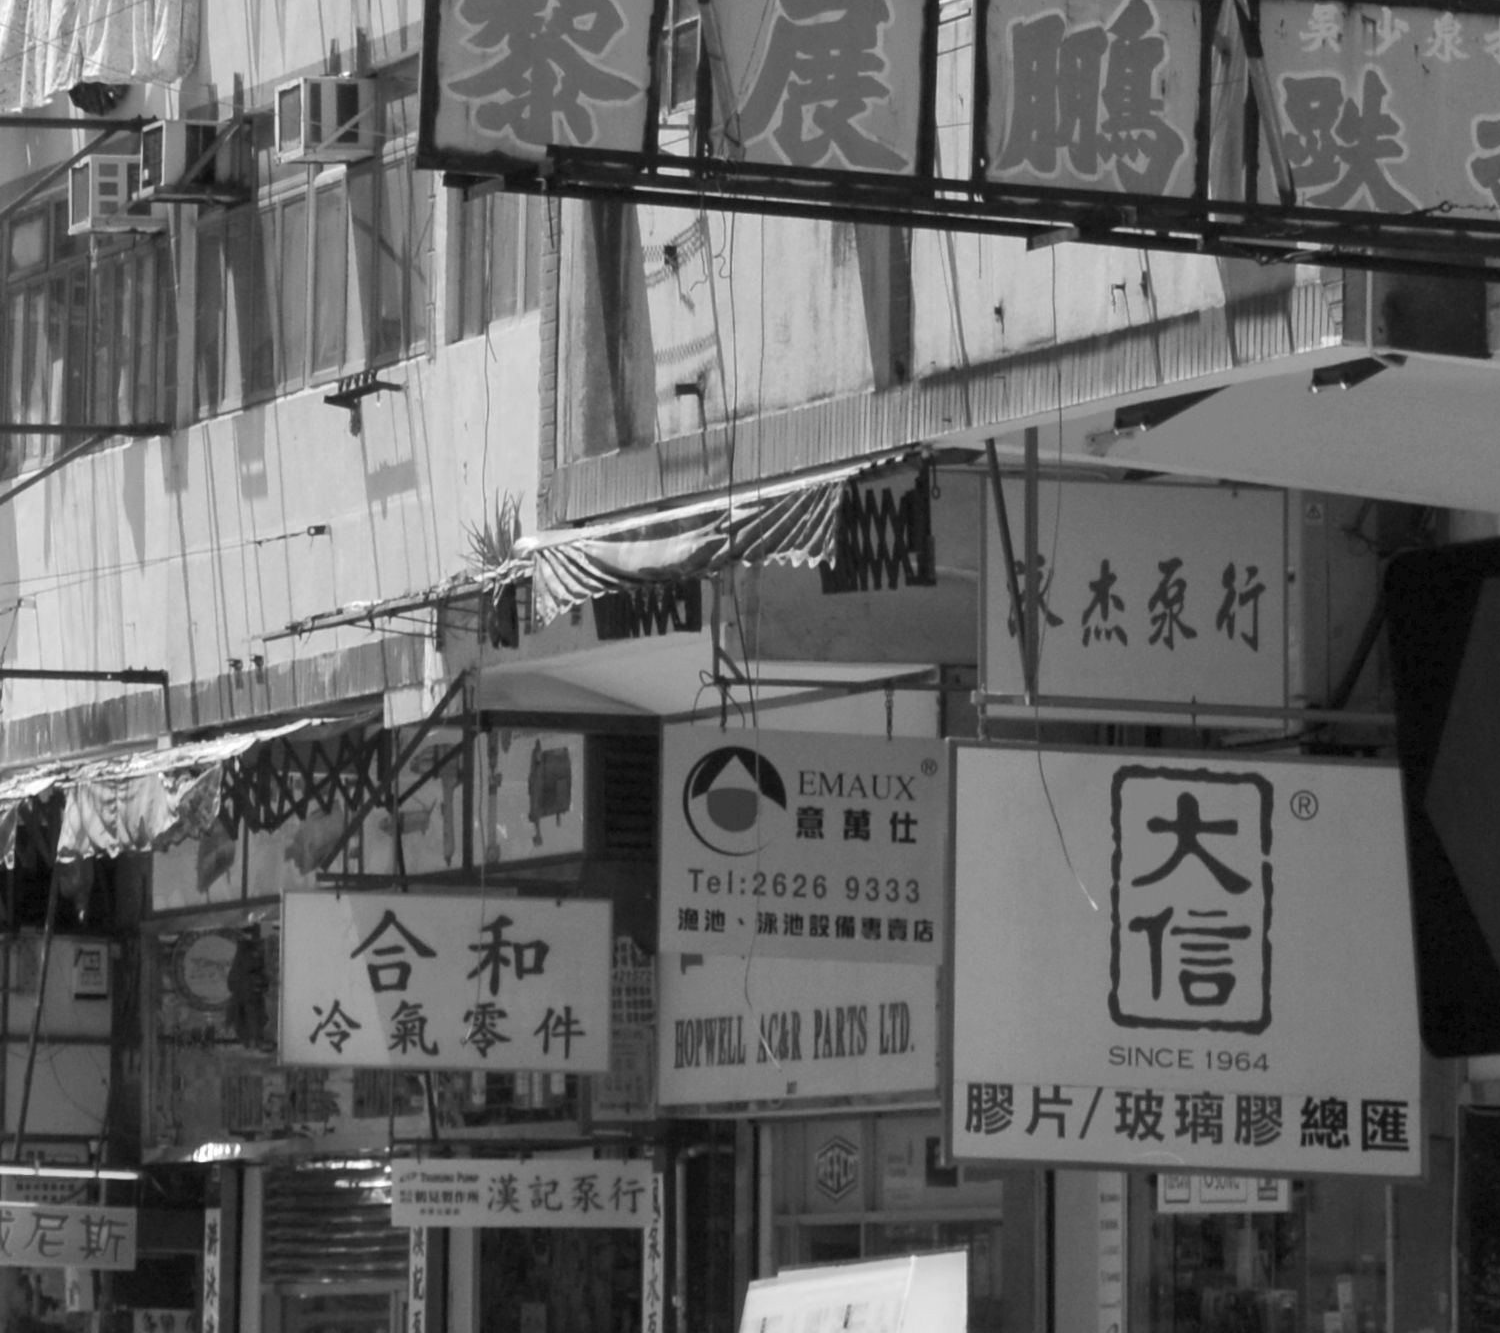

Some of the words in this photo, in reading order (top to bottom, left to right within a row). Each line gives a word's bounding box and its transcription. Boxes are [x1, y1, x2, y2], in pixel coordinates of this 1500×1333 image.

[797, 769, 917, 802] EMAUX
[796, 806, 919, 845] 意萬仕
[844, 875, 921, 904] 9333
[1130, 791, 1253, 1007] 大信
[351, 909, 550, 996] 合和
[309, 999, 586, 1059] 冷氣零件
[673, 1015, 747, 1069] HOPWELL
[756, 1010, 803, 1064] AC&R
[812, 1004, 868, 1060] PARTS
[878, 1001, 916, 1056] LTD.
[1108, 1044, 1196, 1071] SINCE
[1204, 1048, 1270, 1074] 1964
[486, 1173, 646, 1214] 漢記泵行
